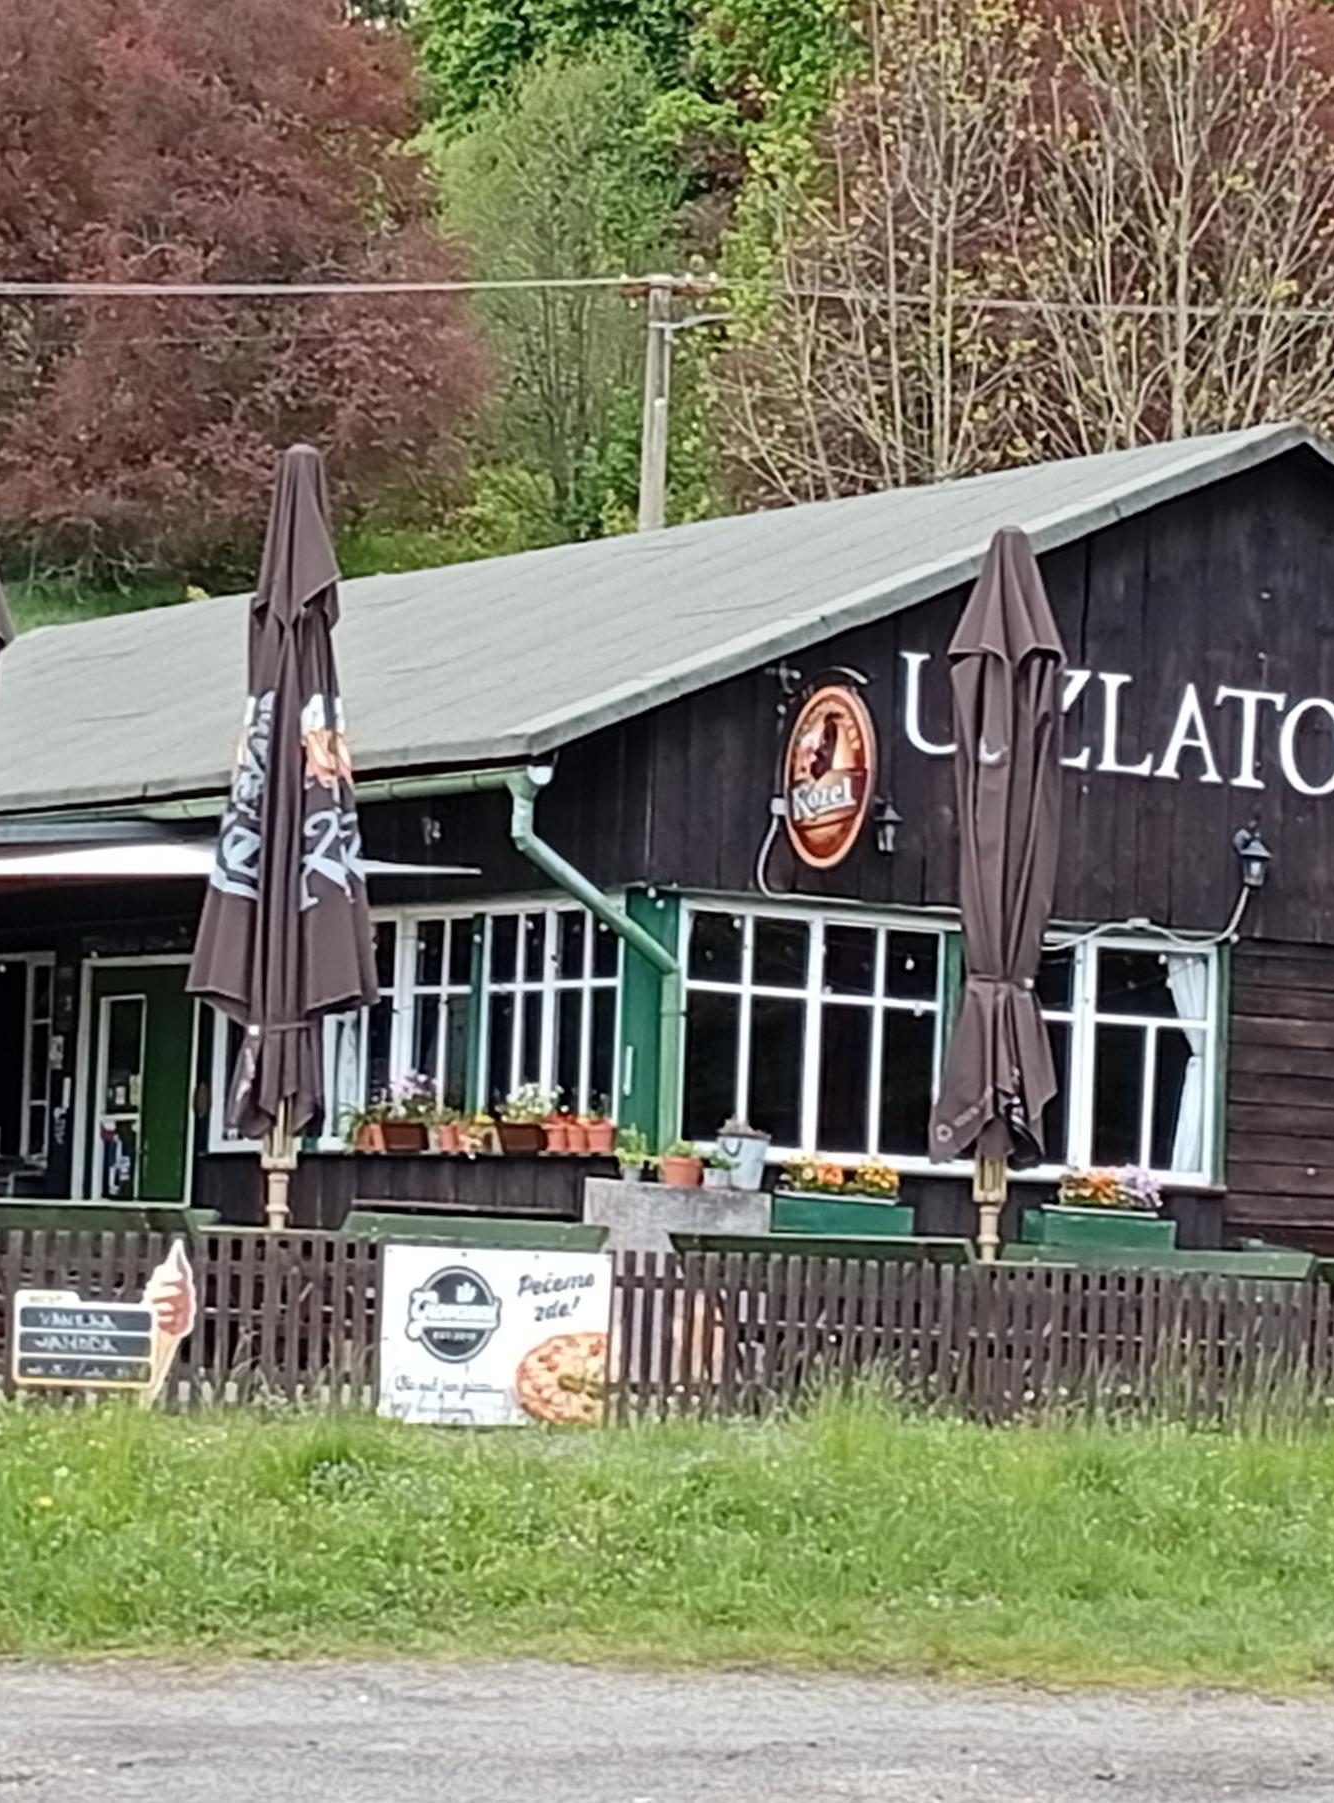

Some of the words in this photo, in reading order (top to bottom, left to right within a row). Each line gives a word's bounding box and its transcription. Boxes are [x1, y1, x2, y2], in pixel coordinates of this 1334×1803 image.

[791, 776, 856, 821] Kozel
[517, 1272, 595, 1297] Pečeme
[534, 1296, 581, 1322] zde!
